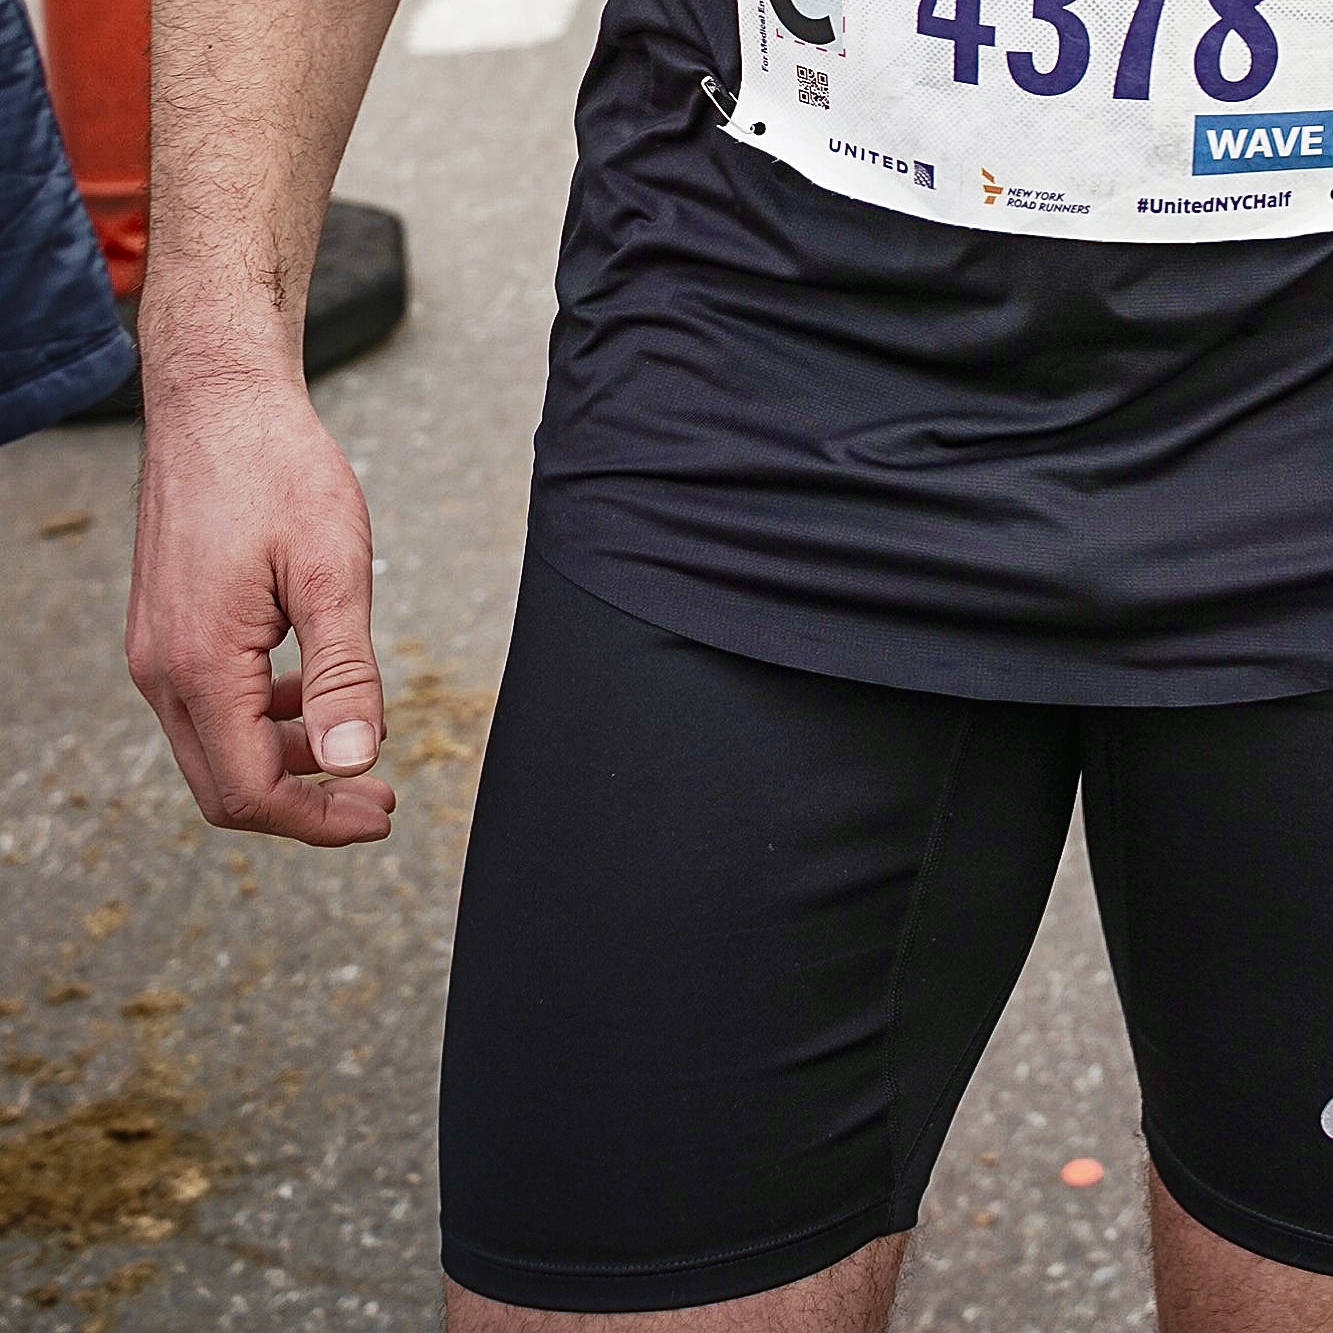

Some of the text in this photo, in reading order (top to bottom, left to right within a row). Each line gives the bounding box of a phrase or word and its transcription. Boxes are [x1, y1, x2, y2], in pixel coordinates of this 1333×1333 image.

[759, 14, 768, 54] Medical
[761, 55, 769, 73] For
[1206, 124, 1325, 161] WAVE
[828, 137, 909, 175] UNITED
[1006, 198, 1092, 215] ROAD RUNNERS
[1007, 186, 1067, 203] NEW YORK
[1136, 190, 1293, 215] #UnitedNYCHalf
